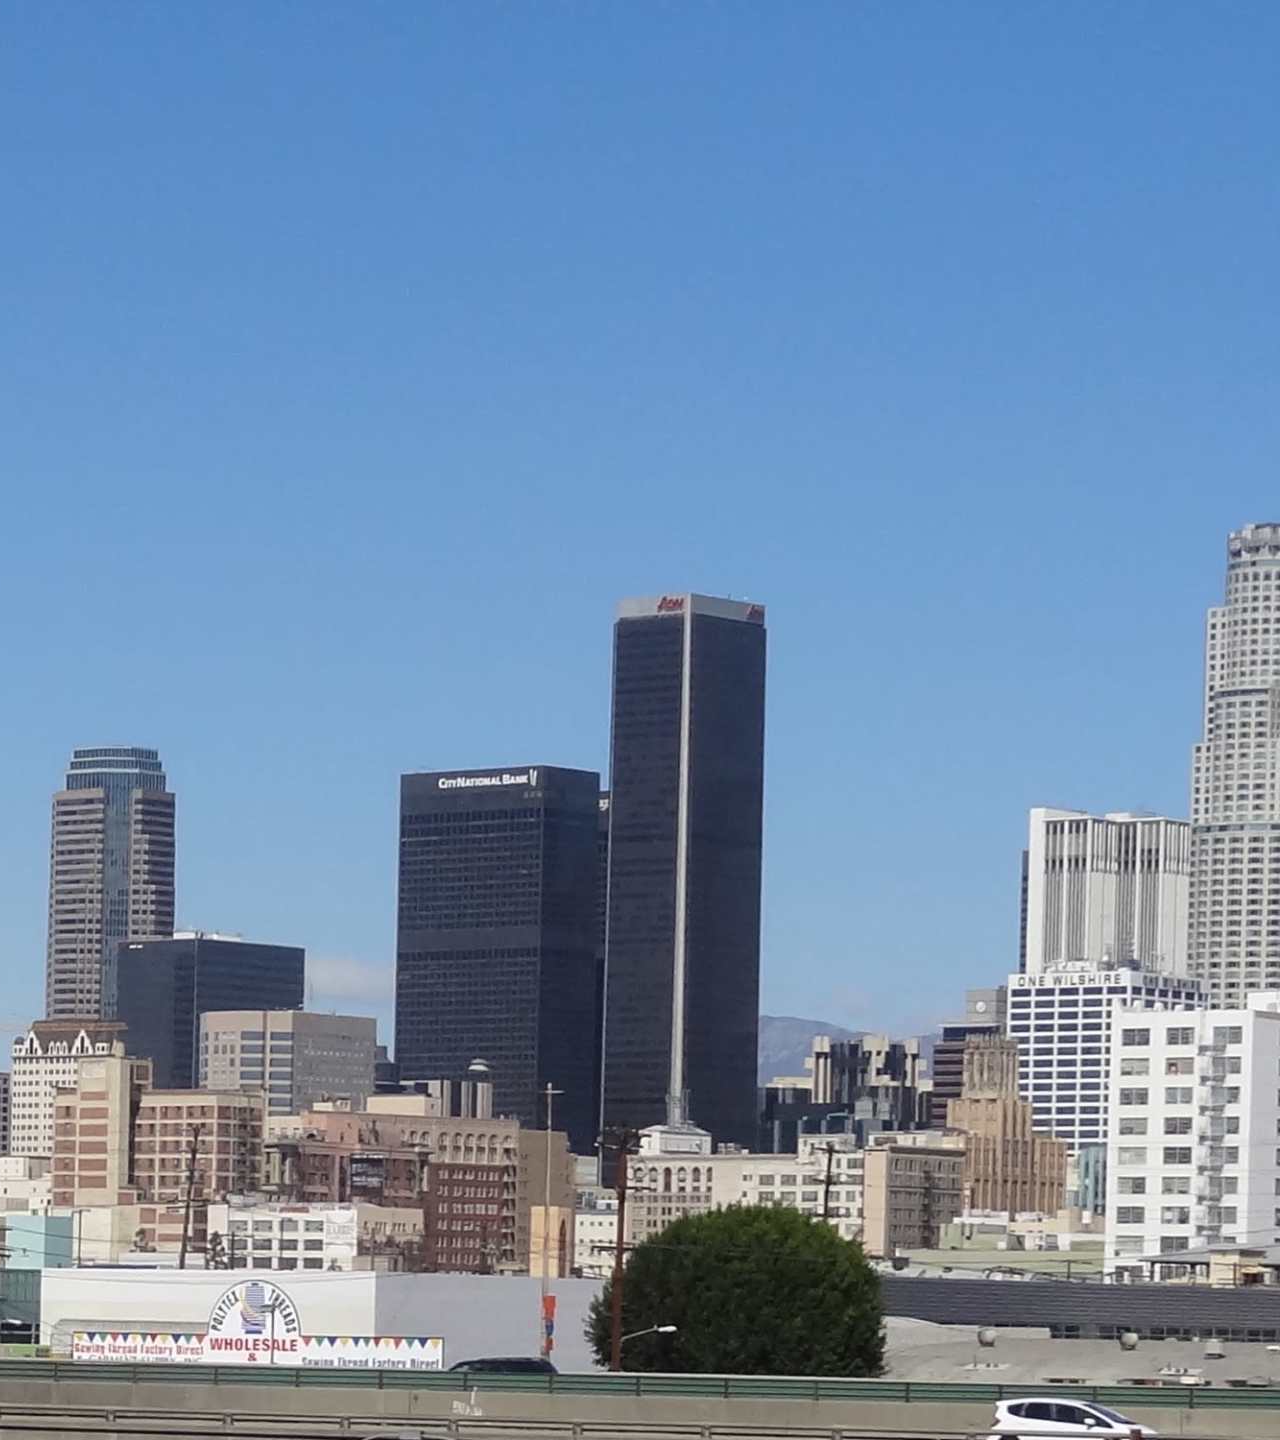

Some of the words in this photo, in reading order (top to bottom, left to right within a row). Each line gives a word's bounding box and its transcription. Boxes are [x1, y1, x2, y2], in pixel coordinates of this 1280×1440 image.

[457, 775, 502, 788] NATIONAL
[502, 773, 529, 785] BANK
[1017, 973, 1046, 987] ONE
[1052, 973, 1122, 986] WILSHIRE
[74, 1343, 106, 1356] Sewing
[107, 1343, 138, 1355] Thread
[140, 1344, 173, 1357] Factory
[175, 1345, 205, 1357] Direct
[208, 1337, 299, 1353] WHOLESALE
[247, 1352, 258, 1363] &
